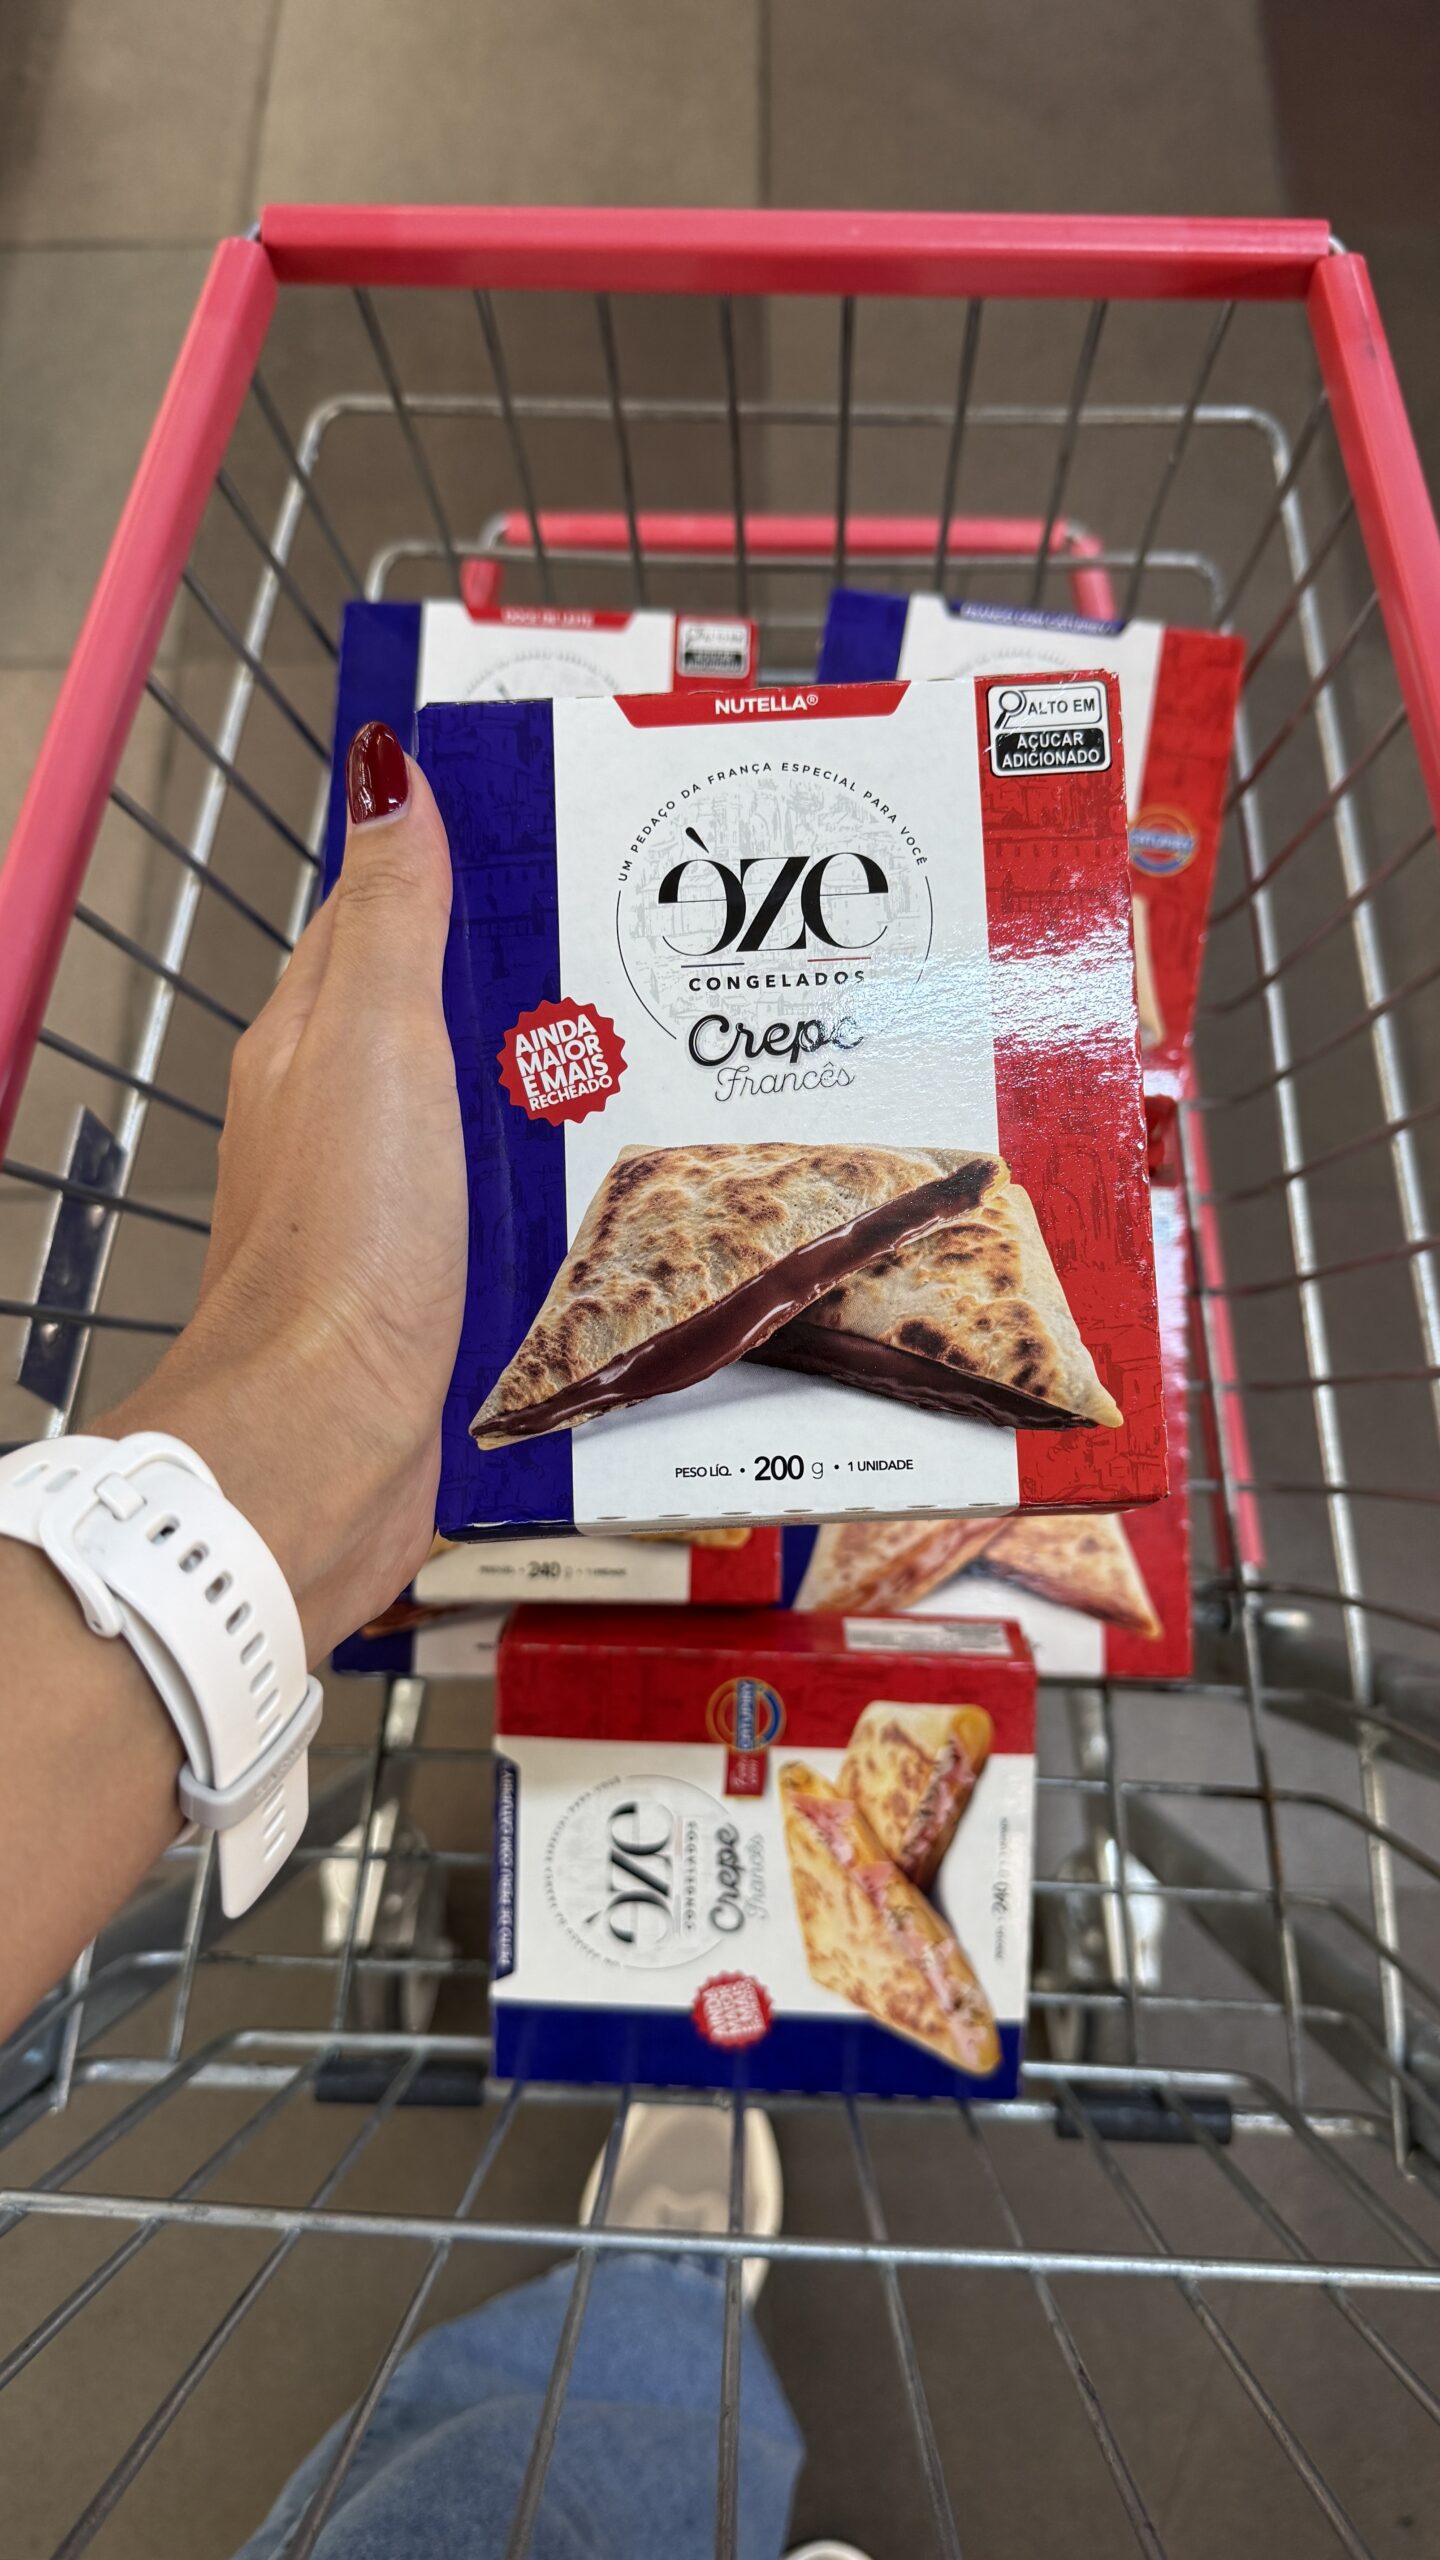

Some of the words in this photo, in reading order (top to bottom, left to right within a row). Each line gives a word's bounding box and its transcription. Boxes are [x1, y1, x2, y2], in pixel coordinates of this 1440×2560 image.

[1027, 700, 1068, 715] ALTO
[1073, 698, 1095, 712] EM
[1002, 748, 1100, 768] ADICIONADO
[1017, 730, 1084, 752] AÇÚCAR
[618, 860, 633, 882] UM
[630, 800, 676, 854] PEDAÇO
[681, 783, 702, 799] DA
[707, 762, 772, 785] FRANÇA
[781, 762, 857, 792] ESPECIAL
[863, 790, 898, 824] PARA
[900, 826, 928, 866] VOCÊ
[688, 970, 866, 992] CONGELADOS
[515, 1014, 597, 1057] AINDA
[516, 1034, 603, 1077] MAIOR
[688, 1014, 864, 1067] Crepe
[522, 1075, 540, 1098] E
[540, 1054, 609, 1093] MAIS
[528, 1075, 613, 1112] RECHEADO
[715, 1061, 856, 1102] Francês
[675, 1466, 707, 1478] PESO
[754, 1454, 805, 1481] 200
[811, 1461, 824, 1479] g
[848, 1462, 854, 1472] 1
[857, 1459, 914, 1472] UNIDADE
[709, 1822, 746, 1933] Crepe
